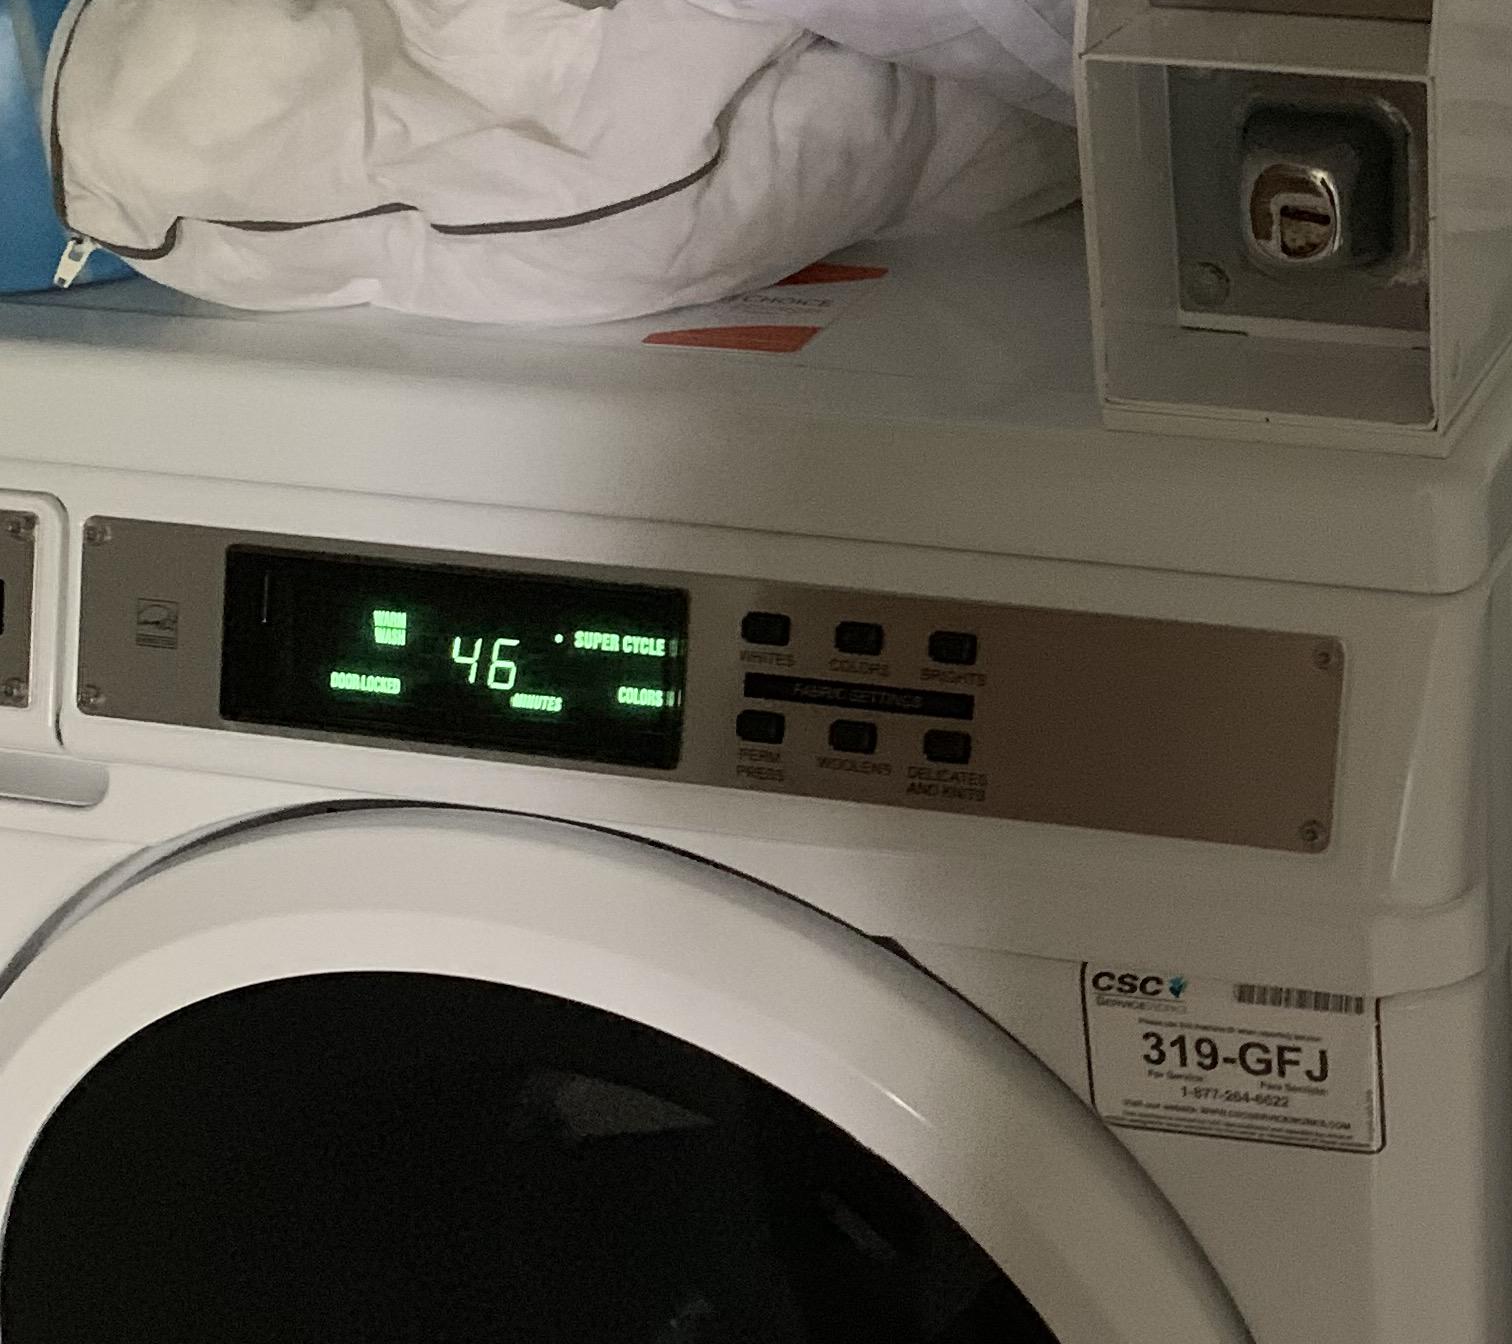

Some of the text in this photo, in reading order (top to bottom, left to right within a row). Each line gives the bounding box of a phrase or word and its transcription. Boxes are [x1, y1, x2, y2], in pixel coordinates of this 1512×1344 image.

[374, 628, 406, 646] WASH
[574, 631, 666, 657] SUPER CYCLE
[452, 636, 520, 690] 46
[330, 672, 401, 694] DOOR LOCKED
[511, 692, 562, 712] MINUTES
[617, 687, 663, 707] COLORS
[739, 747, 781, 764] PERM
[816, 756, 892, 775] WOOLENS
[737, 765, 785, 781] PRESS
[907, 766, 988, 786] DELICATES
[906, 781, 986, 801] AND KNITS
[1091, 971, 1164, 996] CSC
[1142, 1031, 1329, 1083] 319-GFJ
